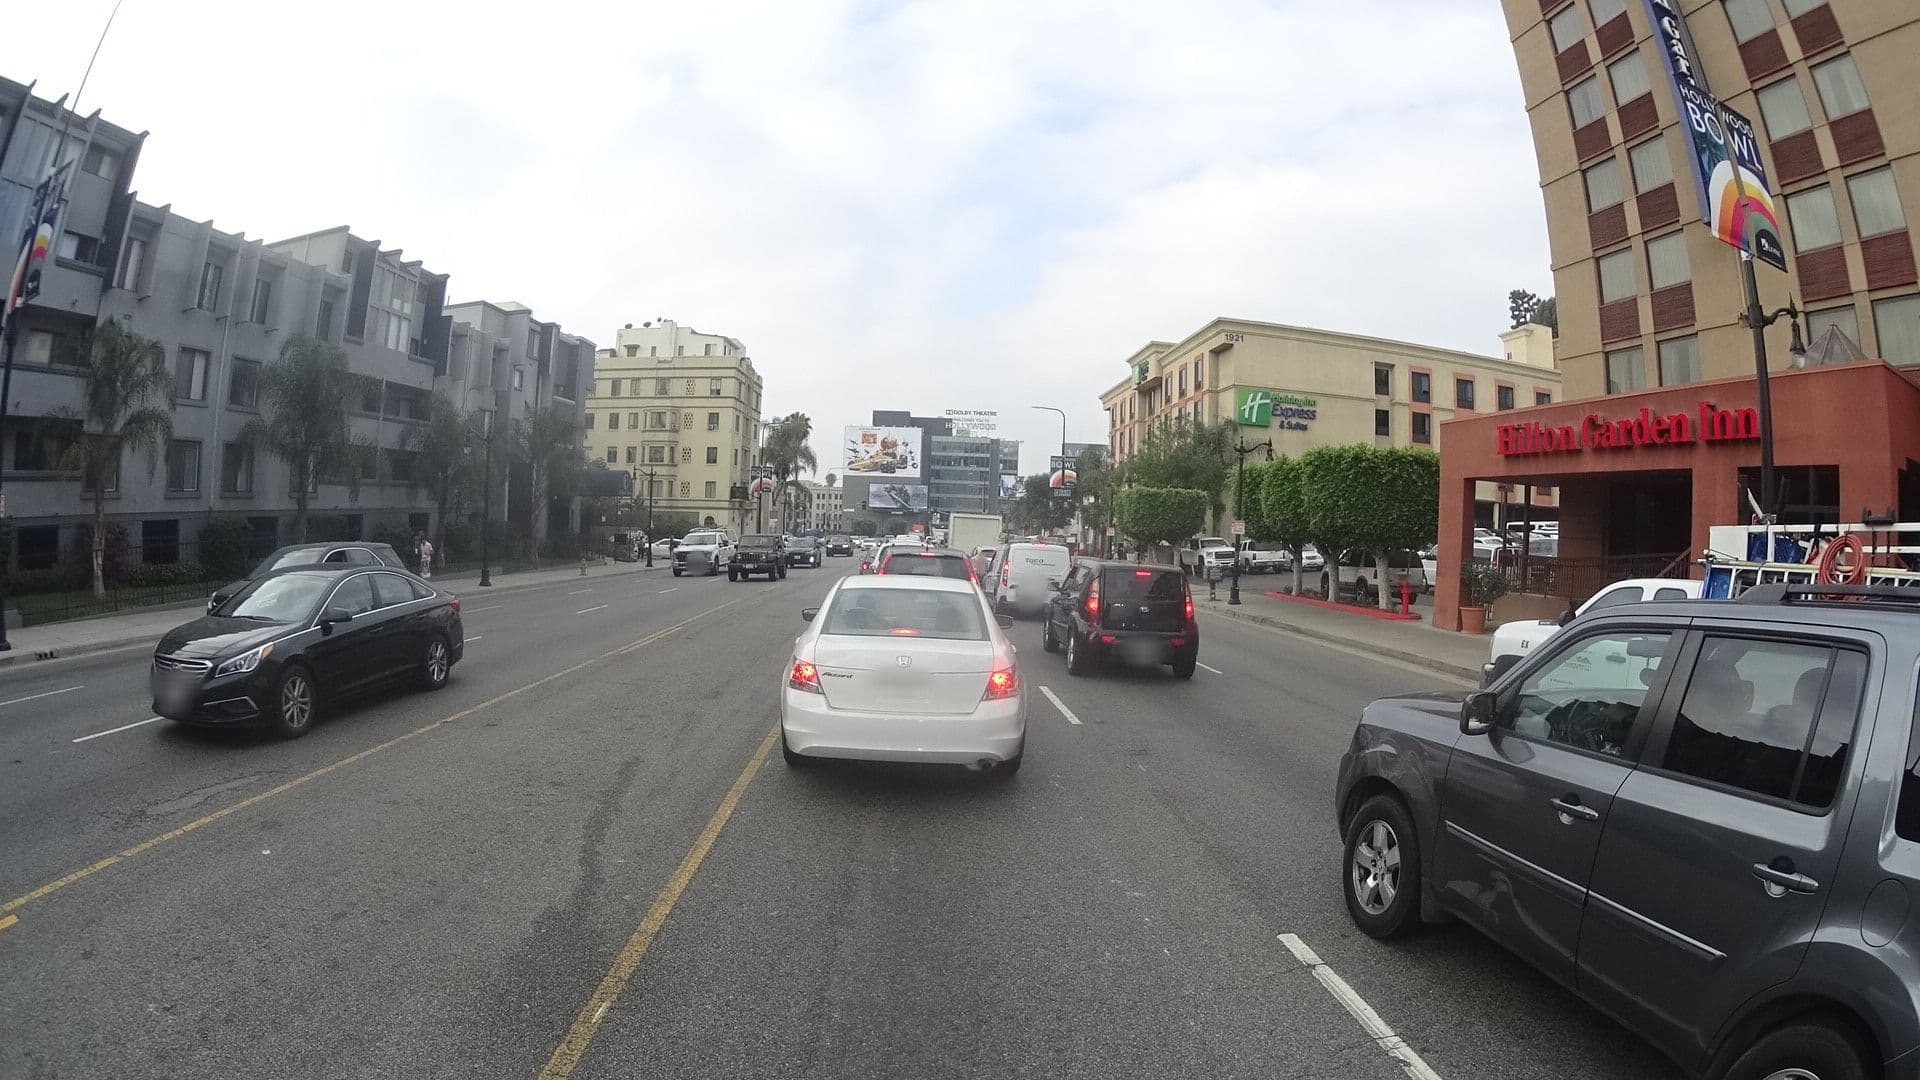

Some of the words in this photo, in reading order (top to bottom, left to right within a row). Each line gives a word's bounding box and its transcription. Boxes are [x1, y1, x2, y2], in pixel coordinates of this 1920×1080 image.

[1685, 100, 1763, 172] BOWL
[1224, 333, 1245, 342] 1921
[1271, 403, 1317, 421] Express
[944, 420, 997, 431] HOLLYWOOD
[1285, 420, 1308, 432] Suites
[1497, 422, 1577, 456] Hilton
[1581, 407, 1691, 449] Garden
[1696, 400, 1761, 441] Inn
[822, 671, 853, 679] Accord
